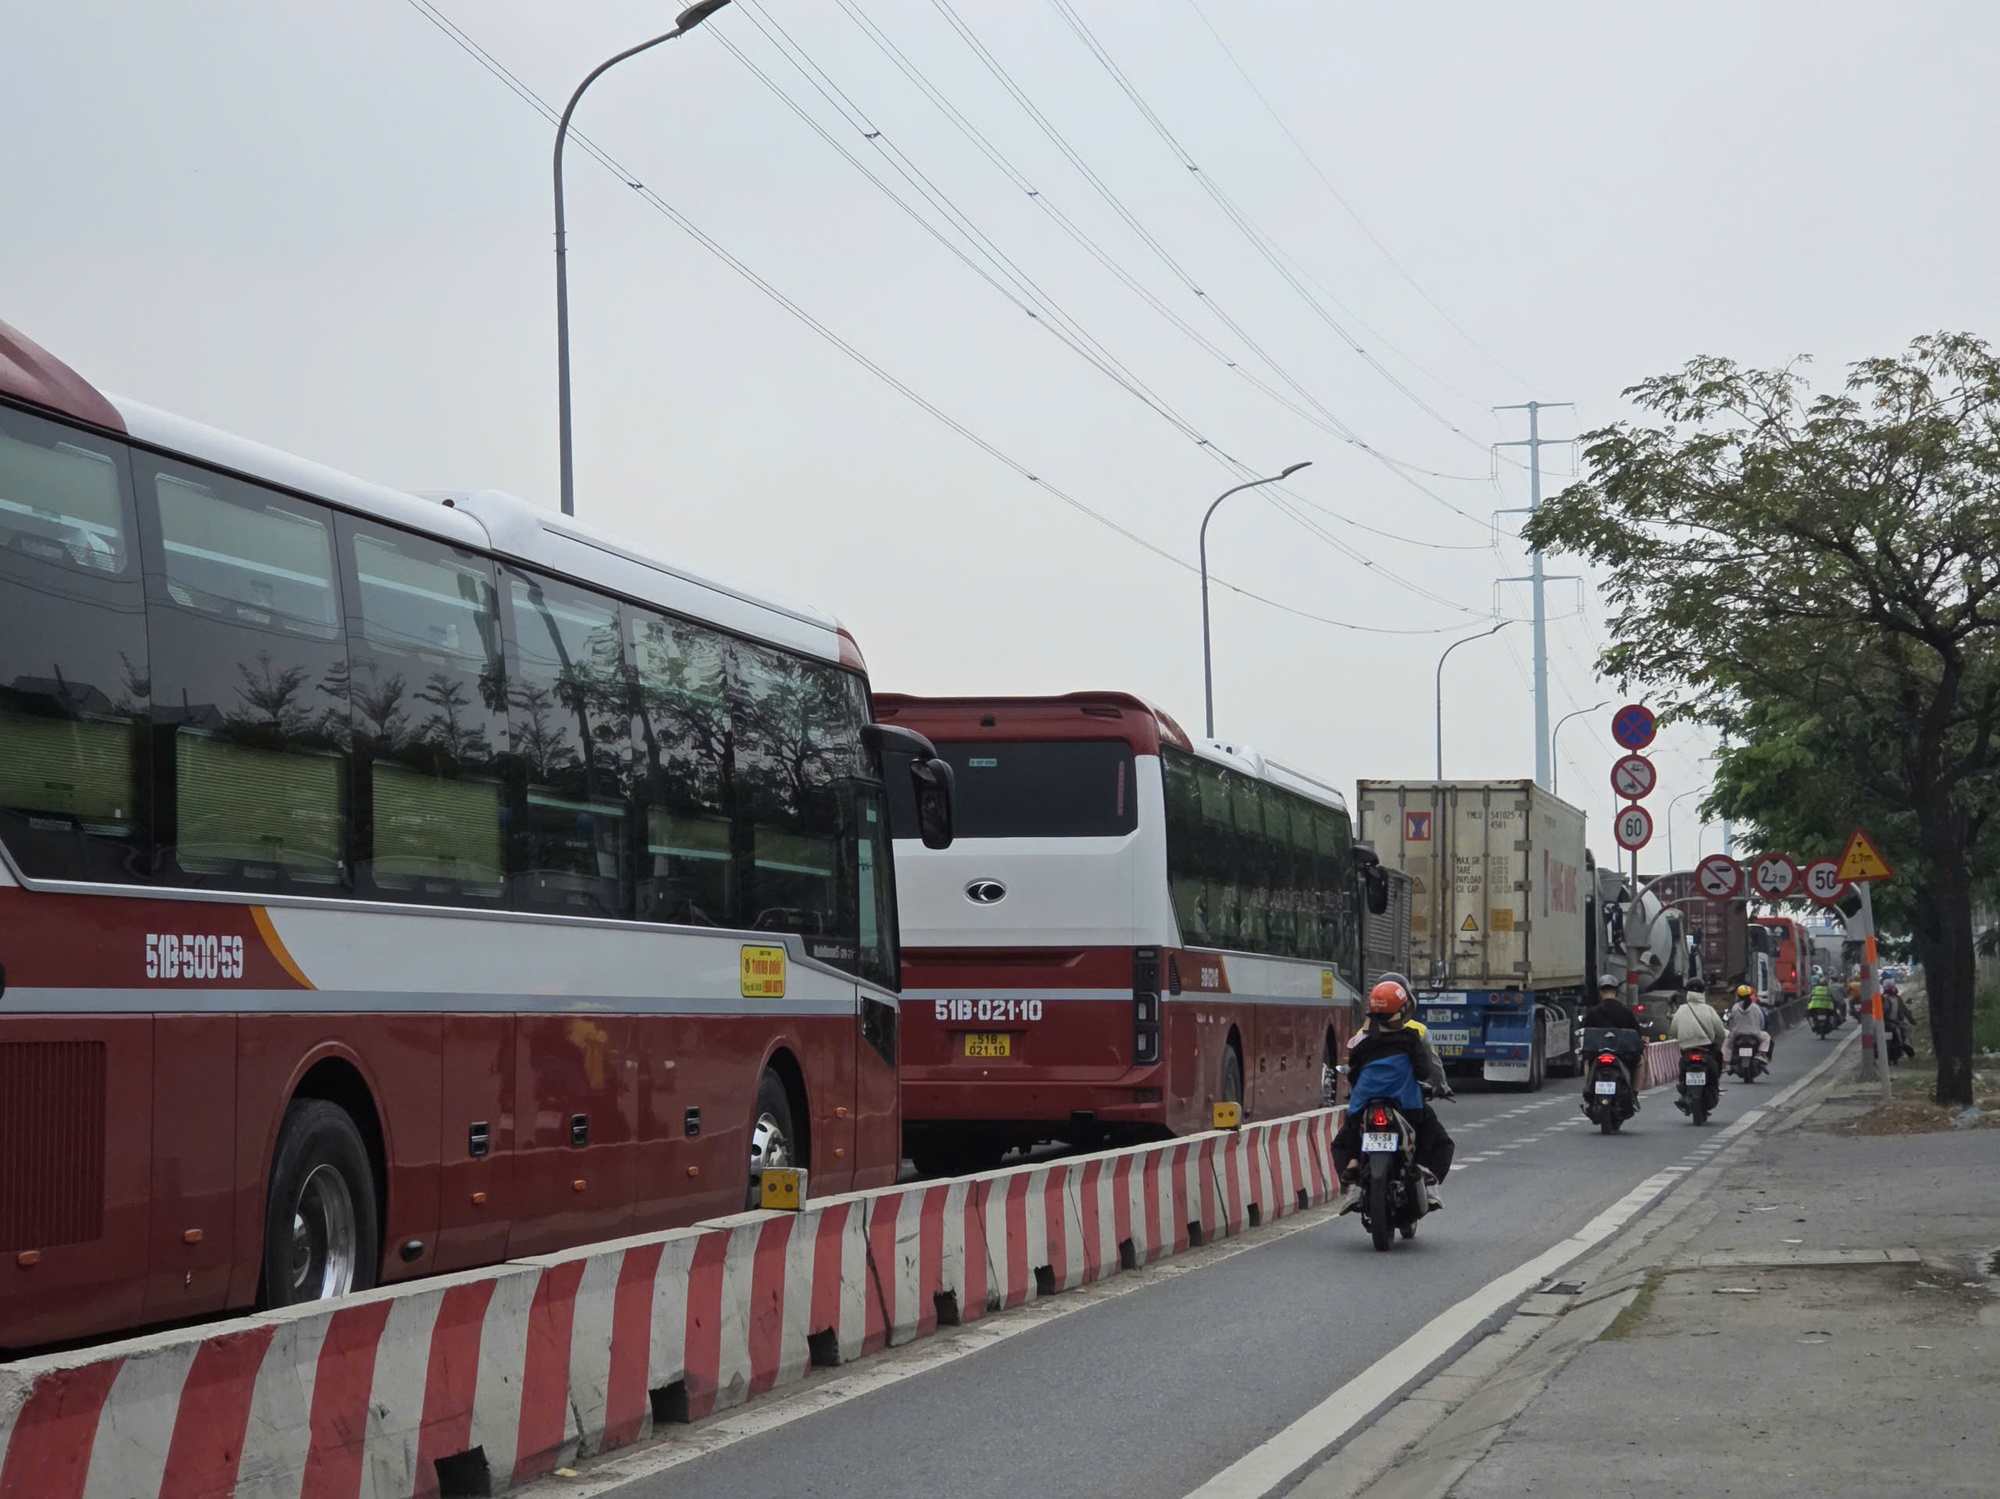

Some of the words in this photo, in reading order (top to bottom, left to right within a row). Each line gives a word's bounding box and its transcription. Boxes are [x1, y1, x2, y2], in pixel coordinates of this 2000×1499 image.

[1466, 811, 1483, 820] YMLU
[1490, 811, 1515, 820] 541025
[1625, 818, 1642, 837] 60
[1456, 866, 1471, 874] TARE
[1456, 876, 1482, 884] PAYLOAD
[1815, 870, 1836, 890] 50
[977, 1034, 998, 1045] 51B
[969, 1045, 1006, 1056] 021.10
